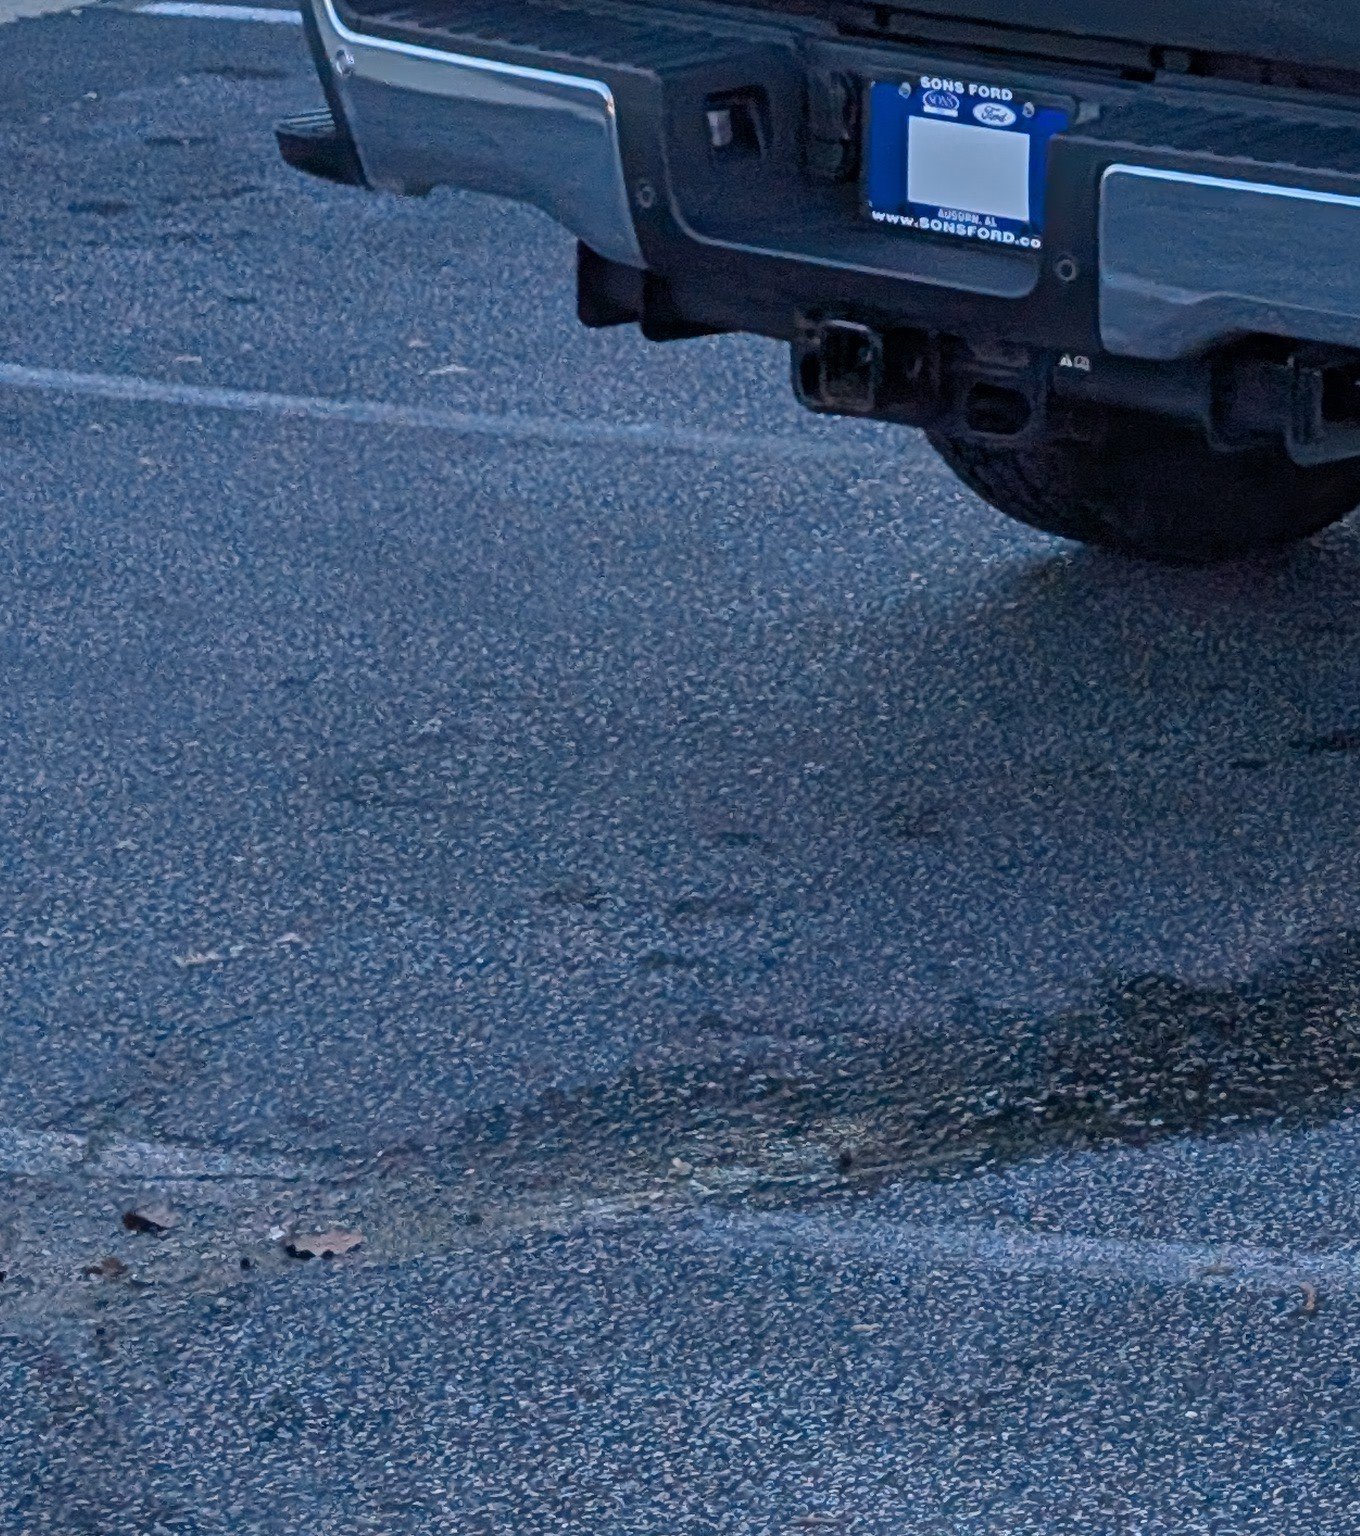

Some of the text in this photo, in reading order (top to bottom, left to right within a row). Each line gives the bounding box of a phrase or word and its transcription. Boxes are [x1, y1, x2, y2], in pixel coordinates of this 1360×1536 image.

[920, 76, 1013, 101] SONS FORD
[871, 210, 1042, 249] www.SONSFORD.co
